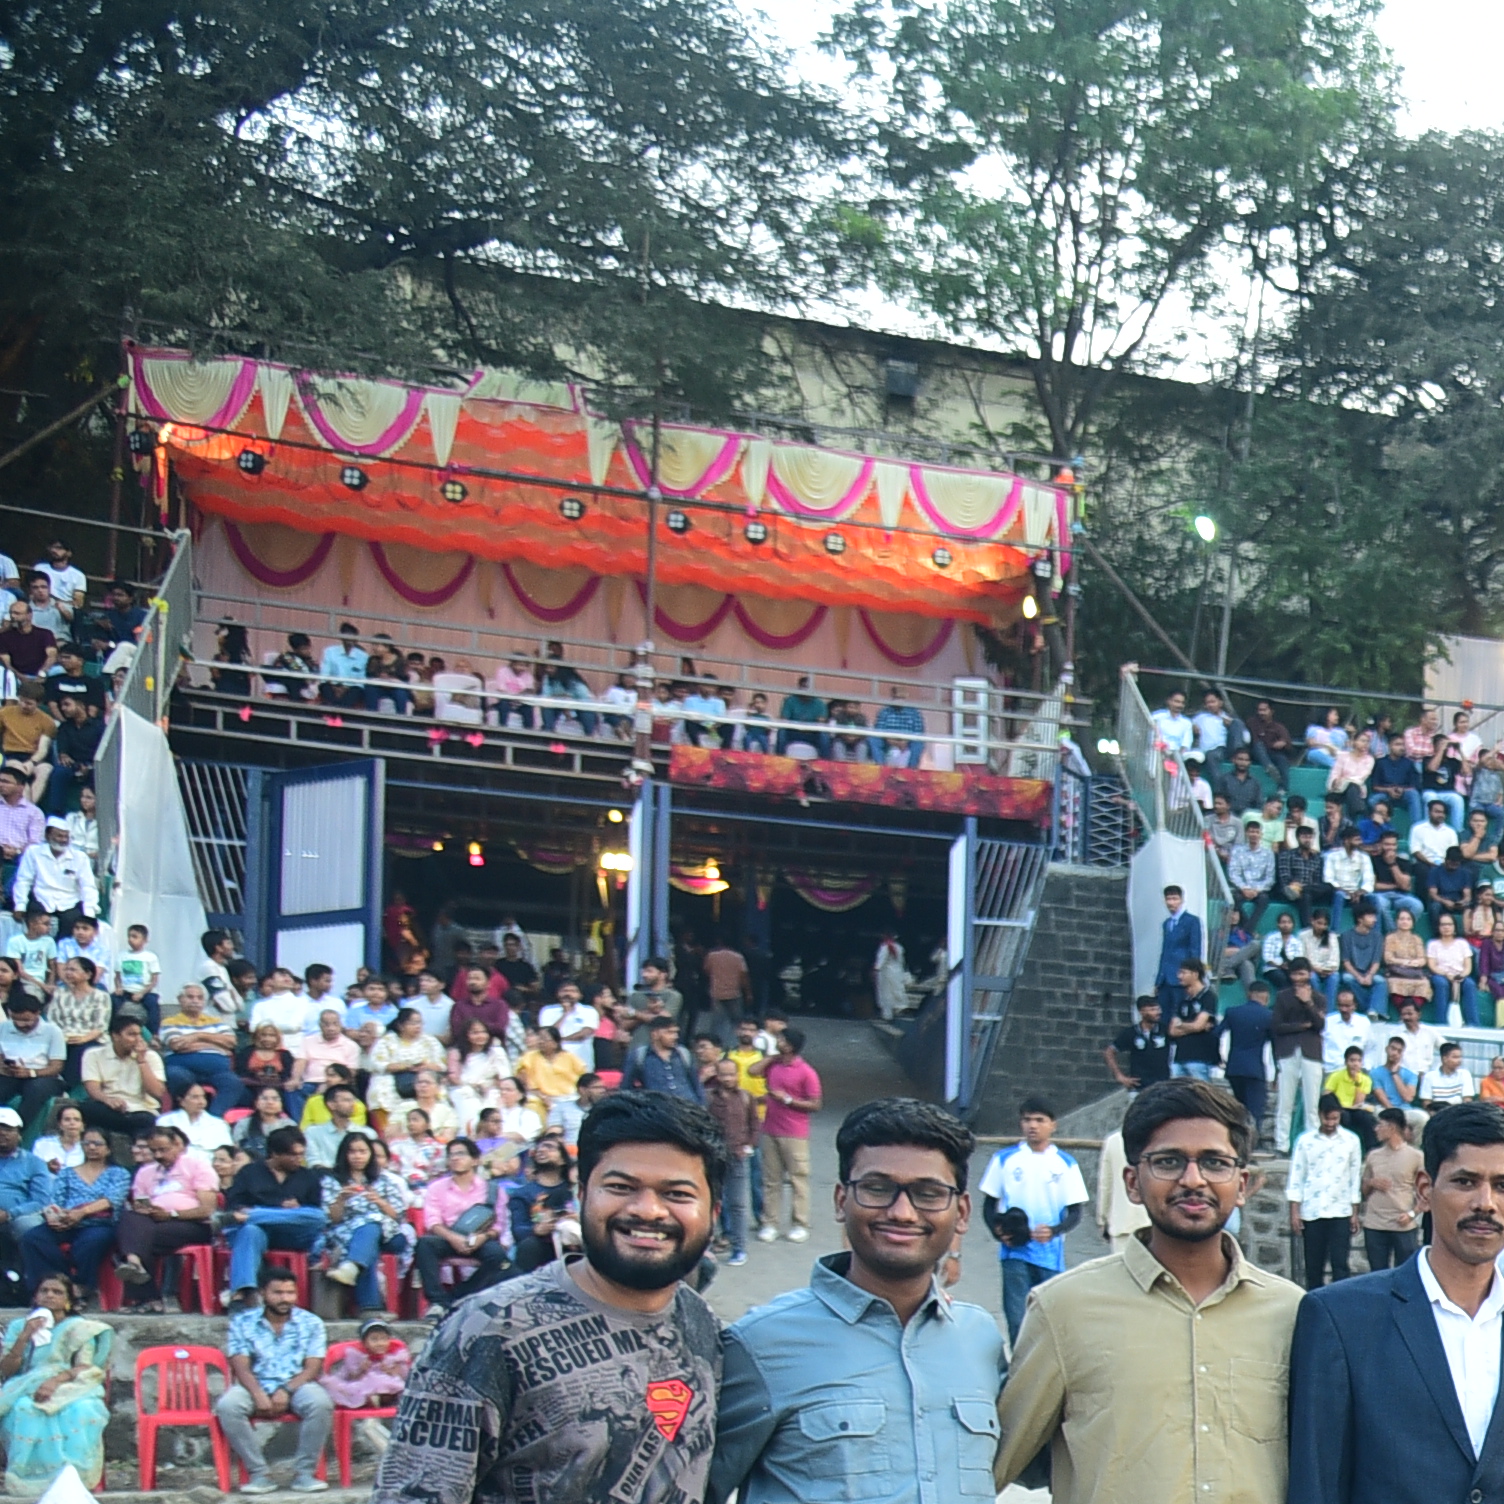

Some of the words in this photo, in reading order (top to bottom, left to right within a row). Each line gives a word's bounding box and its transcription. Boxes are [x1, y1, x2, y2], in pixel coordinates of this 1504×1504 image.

[505, 1314, 611, 1372] SUPERMAN
[516, 1337, 613, 1395] RESCUED
[397, 1417, 477, 1453] SCUED
[638, 1431, 662, 1464] LAS
